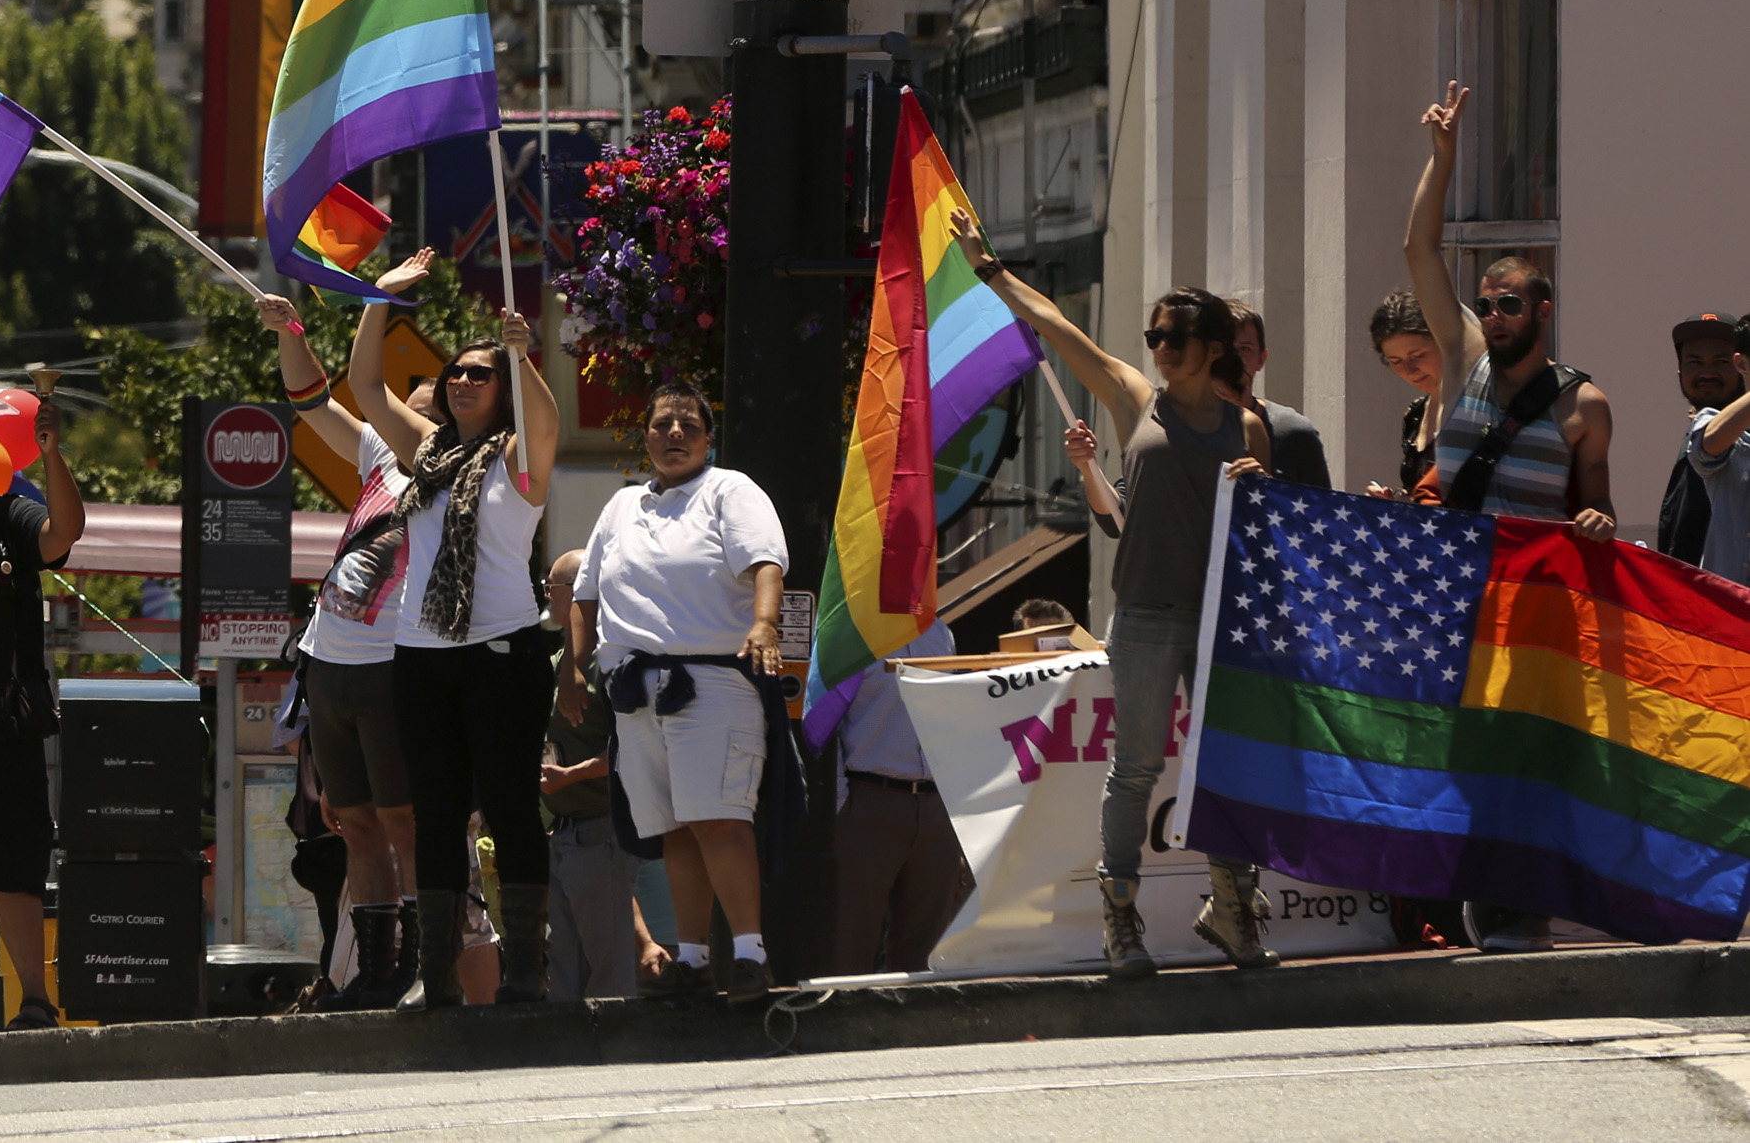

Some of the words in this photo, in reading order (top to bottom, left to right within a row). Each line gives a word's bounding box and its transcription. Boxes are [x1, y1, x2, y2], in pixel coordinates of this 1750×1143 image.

[202, 499, 223, 519] 24
[201, 522, 222, 542] 35
[201, 623, 219, 641] NO
[221, 623, 288, 635] STOPPING
[231, 636, 279, 646] ANYTIME
[245, 708, 263, 720] 24
[1279, 889, 1358, 926] Prop
[1368, 891, 1390, 915] 8
[89, 914, 124, 924] CASTRO
[126, 914, 165, 926] COURIER
[84, 954, 170, 966] SFAdvertiser.com
